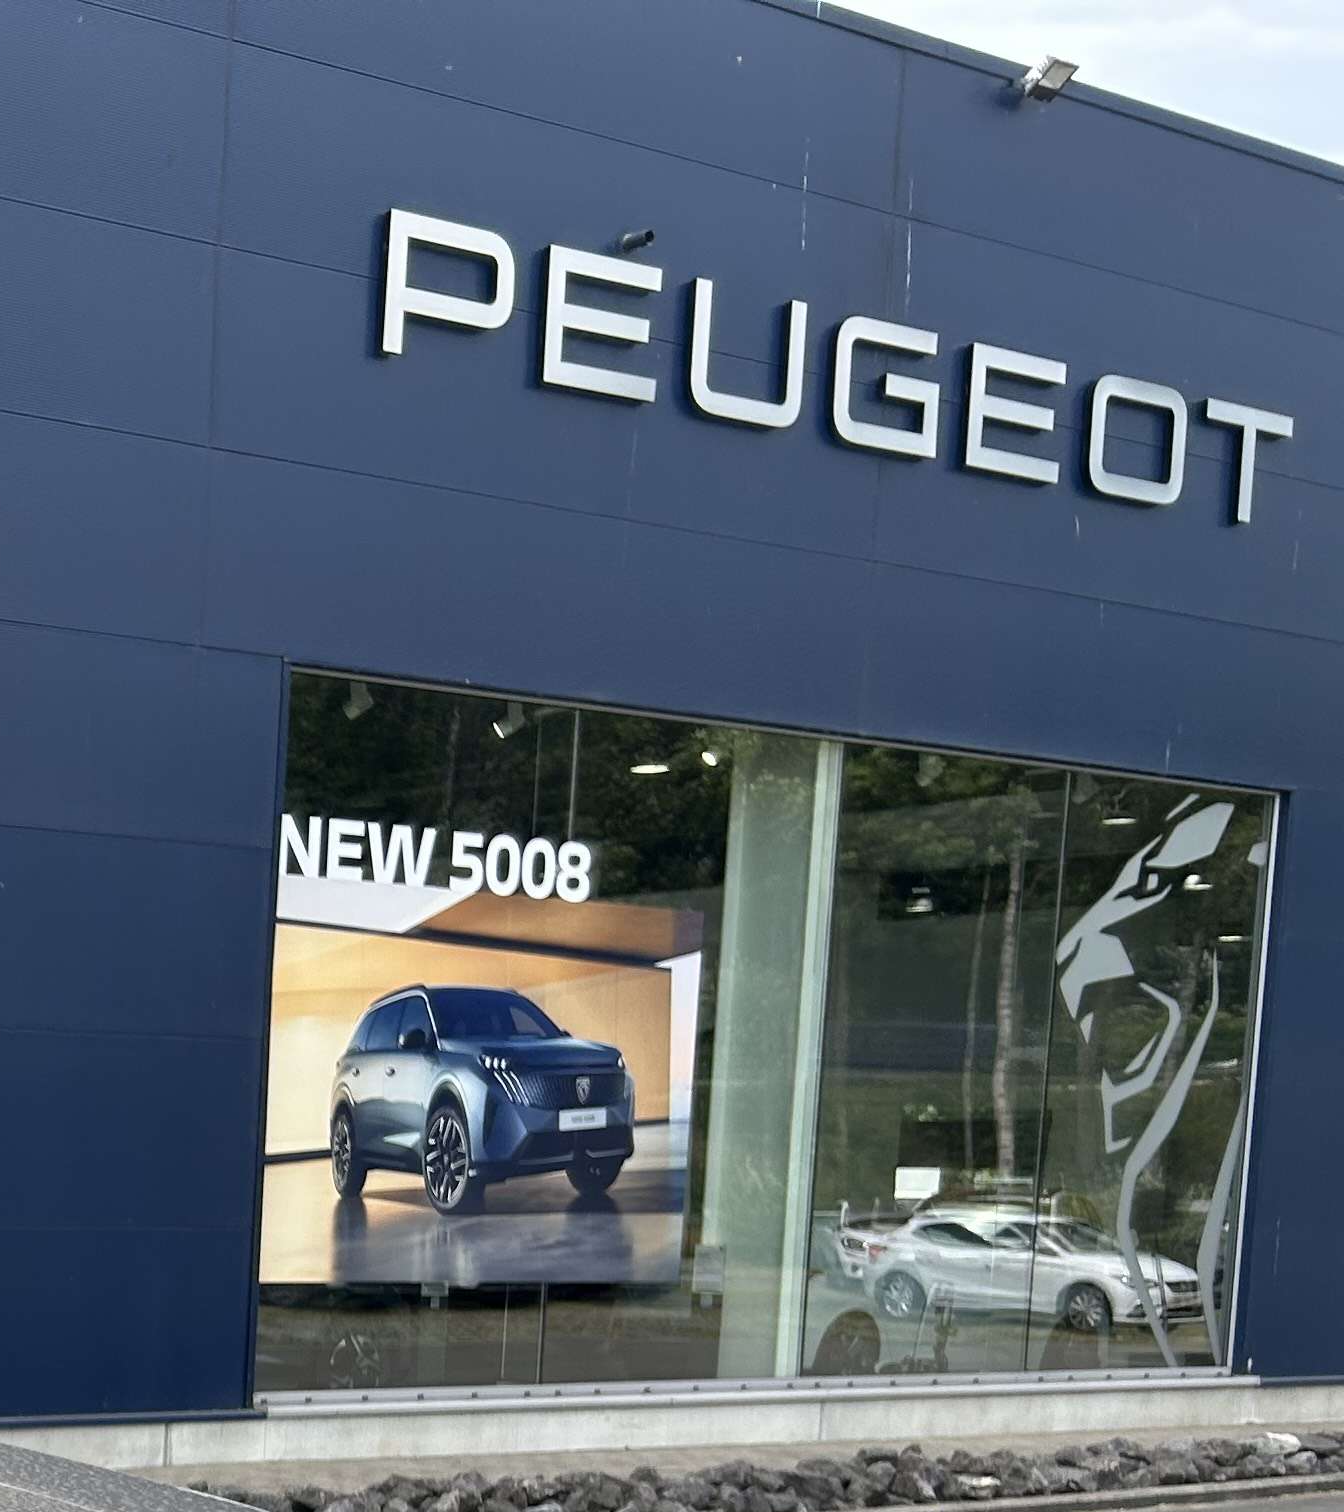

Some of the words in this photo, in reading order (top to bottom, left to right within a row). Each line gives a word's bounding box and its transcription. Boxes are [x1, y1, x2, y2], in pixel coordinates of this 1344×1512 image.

[380, 207, 1295, 524] PEUGEOT
[279, 813, 436, 888] NEW
[449, 831, 592, 904] 5008
